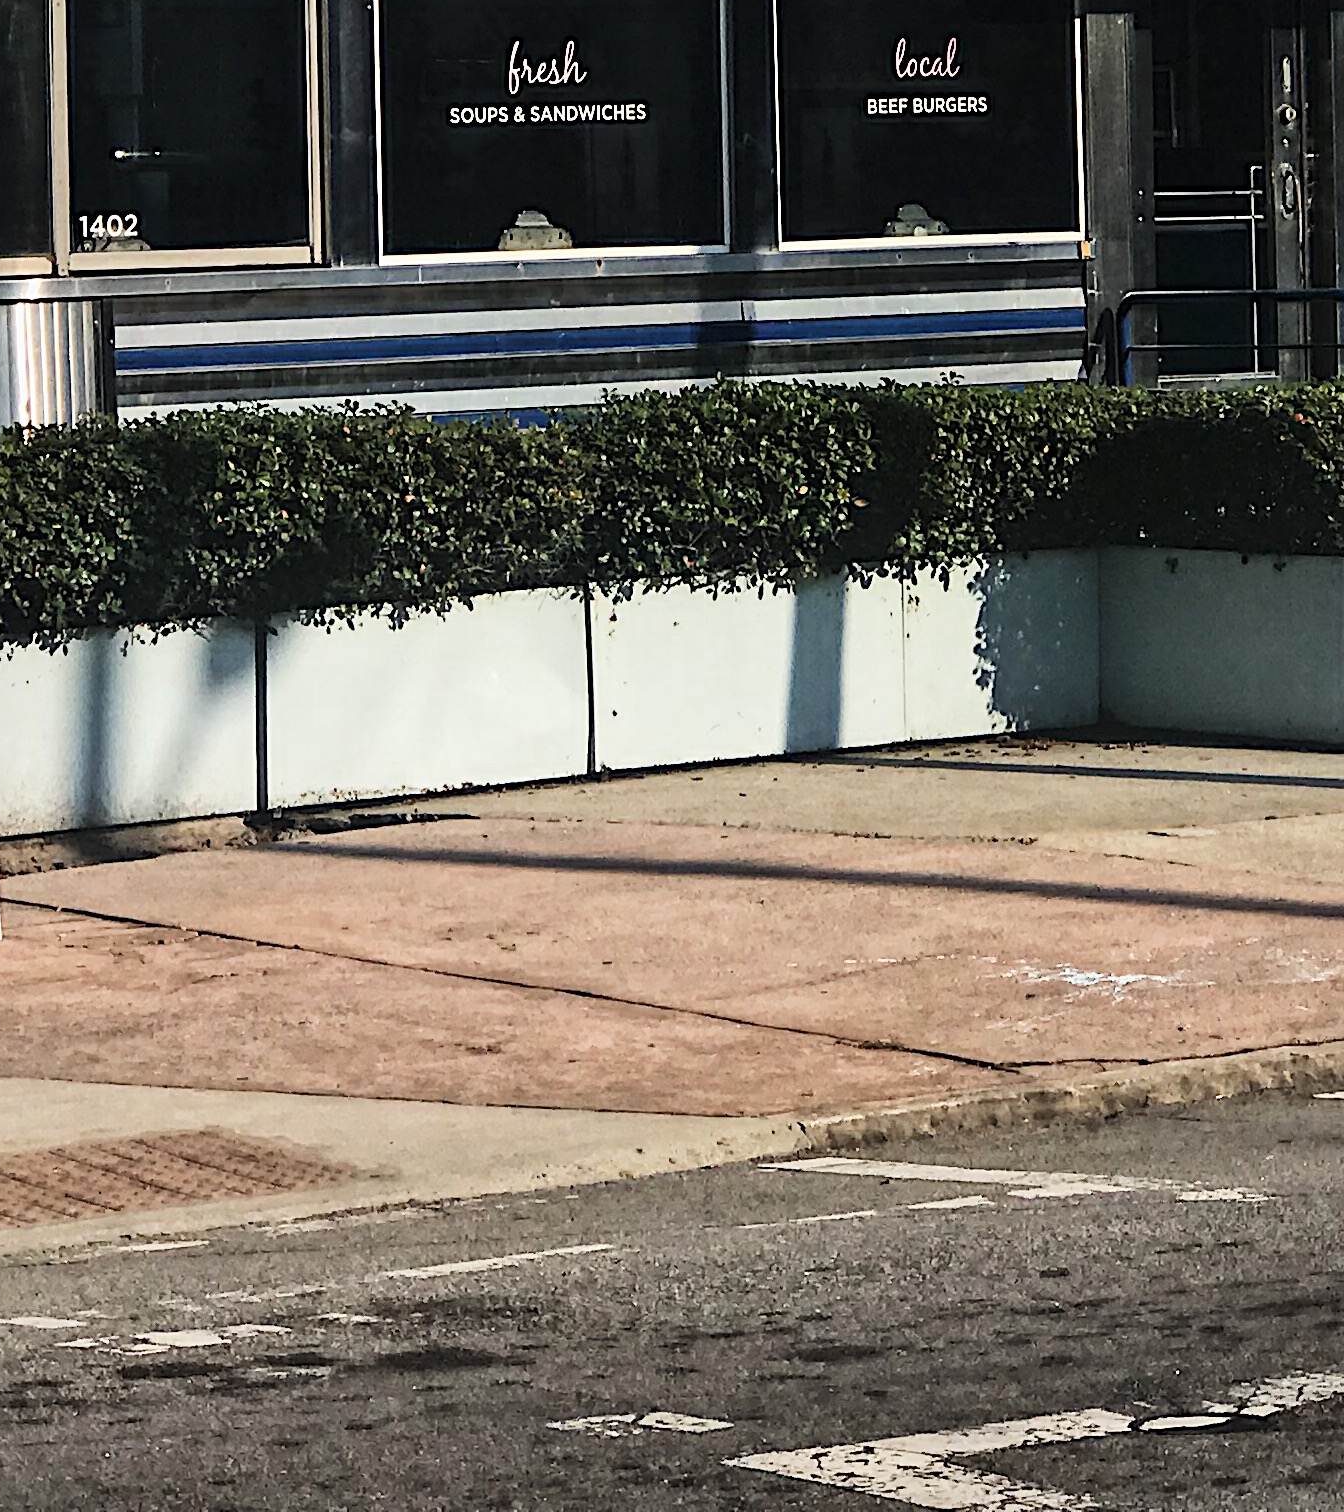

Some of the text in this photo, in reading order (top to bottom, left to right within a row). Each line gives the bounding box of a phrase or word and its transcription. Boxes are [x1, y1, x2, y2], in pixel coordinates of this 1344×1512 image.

[508, 40, 588, 95] fresh
[895, 37, 961, 79] local
[449, 103, 647, 124] SOUPS & SANDWICHES
[867, 96, 988, 115] BEEF BURGERS
[78, 213, 139, 238] 1402
